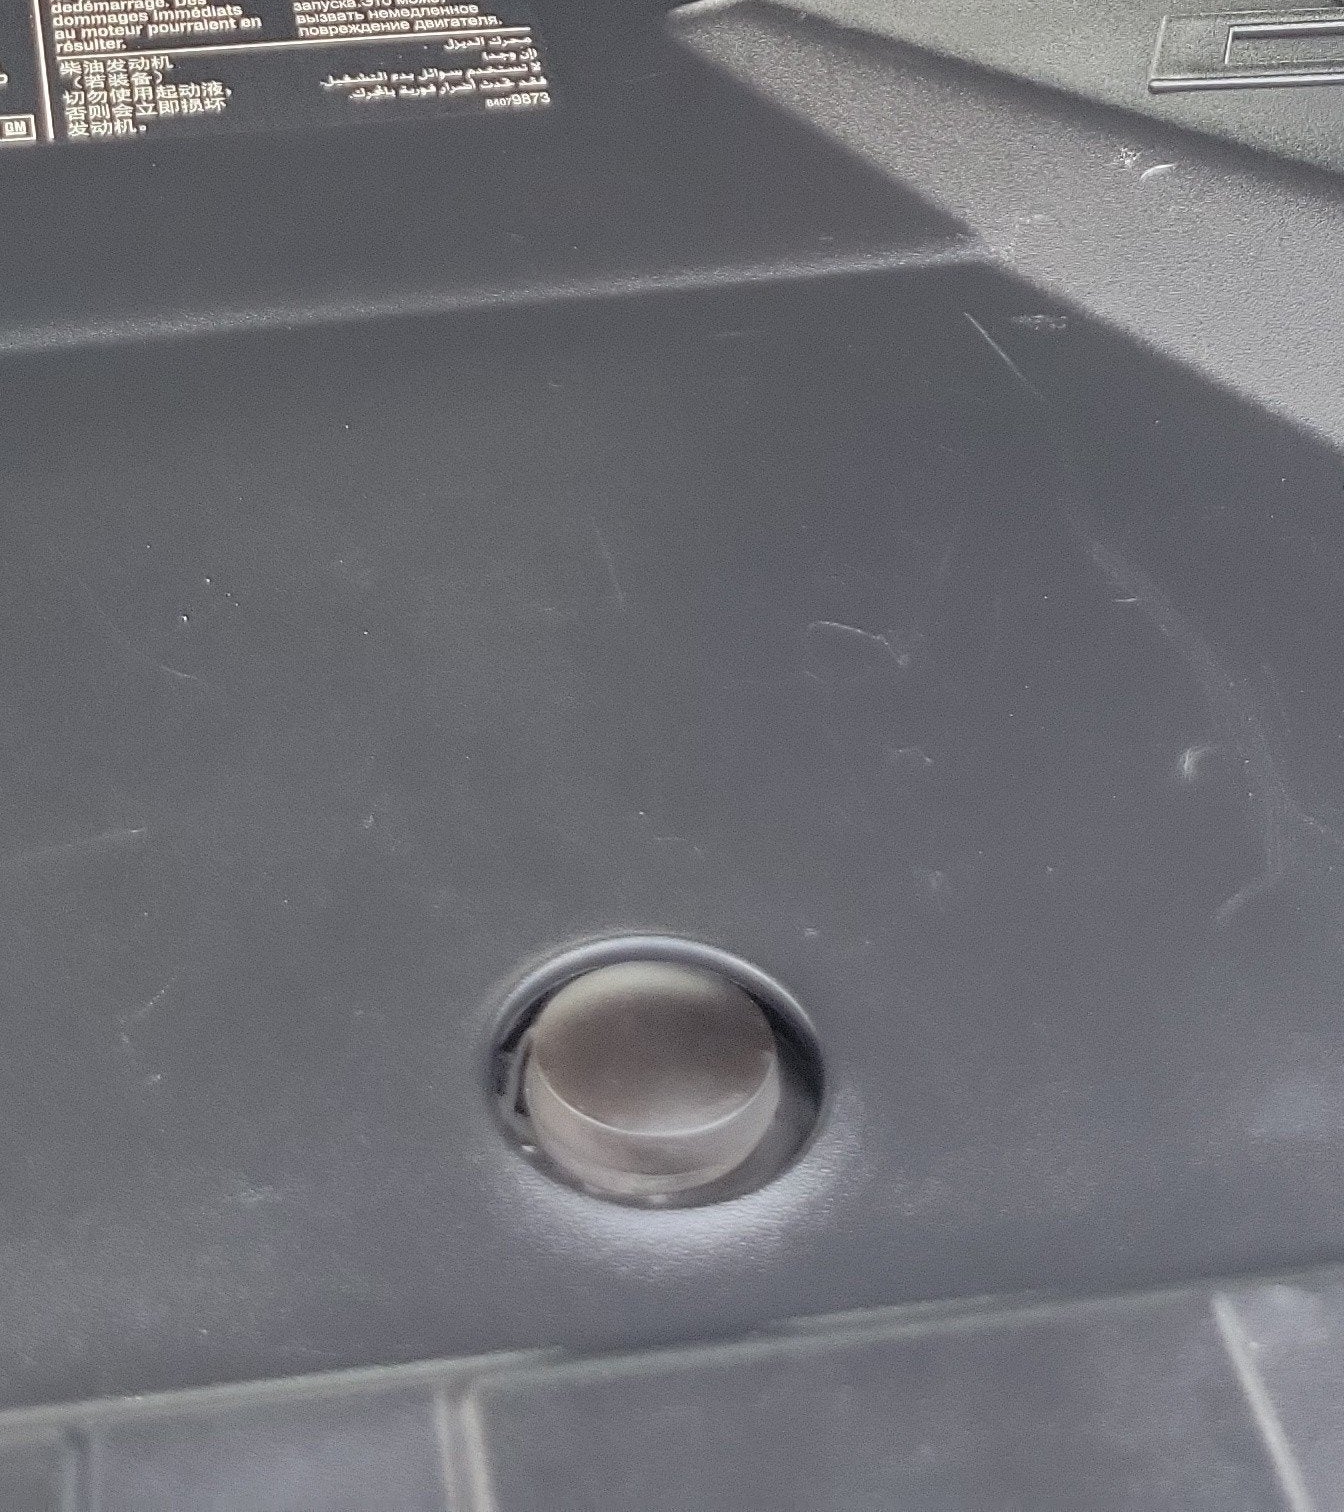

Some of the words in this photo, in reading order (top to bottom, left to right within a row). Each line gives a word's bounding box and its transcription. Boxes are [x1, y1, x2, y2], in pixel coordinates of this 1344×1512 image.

[53, 12, 149, 27] dommages
[153, 4, 243, 22] immédiats
[296, 10, 365, 24] вызвать
[368, 4, 479, 20] немедленное
[55, 28, 76, 40] au
[81, 24, 143, 38] moteur
[147, 19, 237, 37] pourraient
[240, 16, 262, 29] en
[298, 20, 410, 38] повреждение
[413, 15, 503, 31] двигателя.
[56, 39, 127, 54] résulter.
[488, 36, 532, 46] محرك
[60, 55, 174, 75] 柴油发动机
[530, 62, 542, 72] لا
[65, 98, 227, 121] 否则会立即损坏
[5, 120, 27, 133] GM
[68, 119, 147, 137] 发动机。
